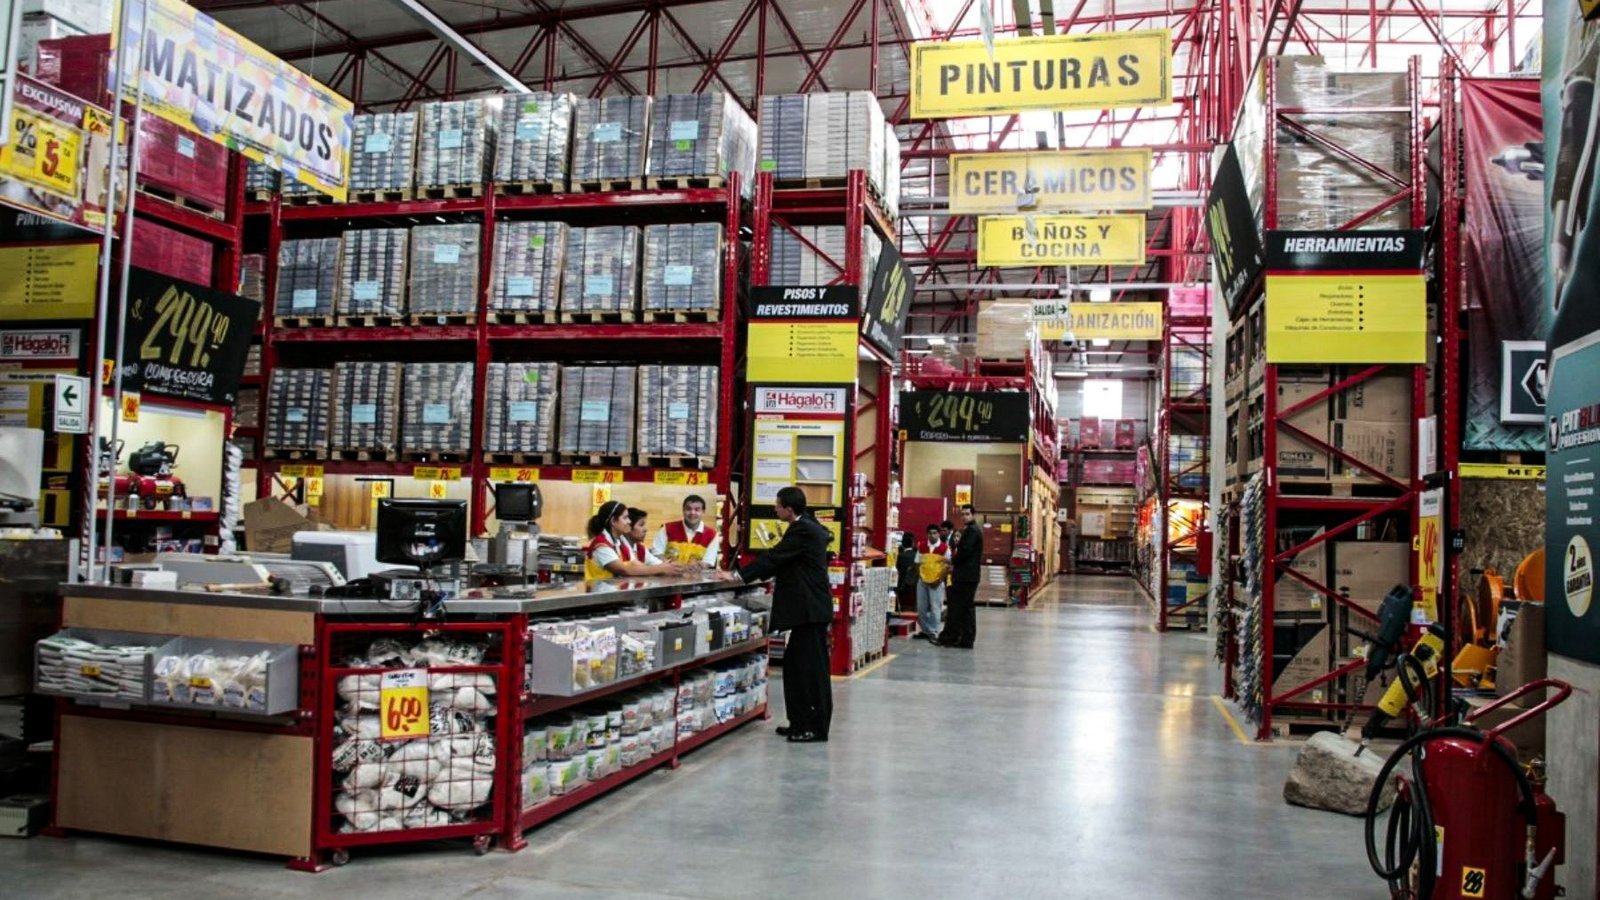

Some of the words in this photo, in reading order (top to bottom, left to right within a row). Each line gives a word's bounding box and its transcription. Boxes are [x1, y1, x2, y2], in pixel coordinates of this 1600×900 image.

[940, 54, 1140, 96] PINTURAS
[22, 83, 82, 119] EXCLUSIVA
[144, 28, 334, 162] MATIZADOS
[965, 166, 1137, 196] CERMICOS
[1098, 225, 1112, 240] Y
[1021, 243, 1102, 258] COCINA
[1284, 237, 1406, 252] HERRAMIENTAS
[784, 288, 816, 300] PISOS
[818, 288, 827, 299] Y
[757, 304, 849, 316] REVESTIMIENTOS
[1034, 304, 1055, 316] SALIDA
[15, 336, 59, 354] Hágalo
[777, 392, 824, 409] Hágalo
[58, 417, 80, 427] SALIDA
[1569, 544, 1576, 572] 2
